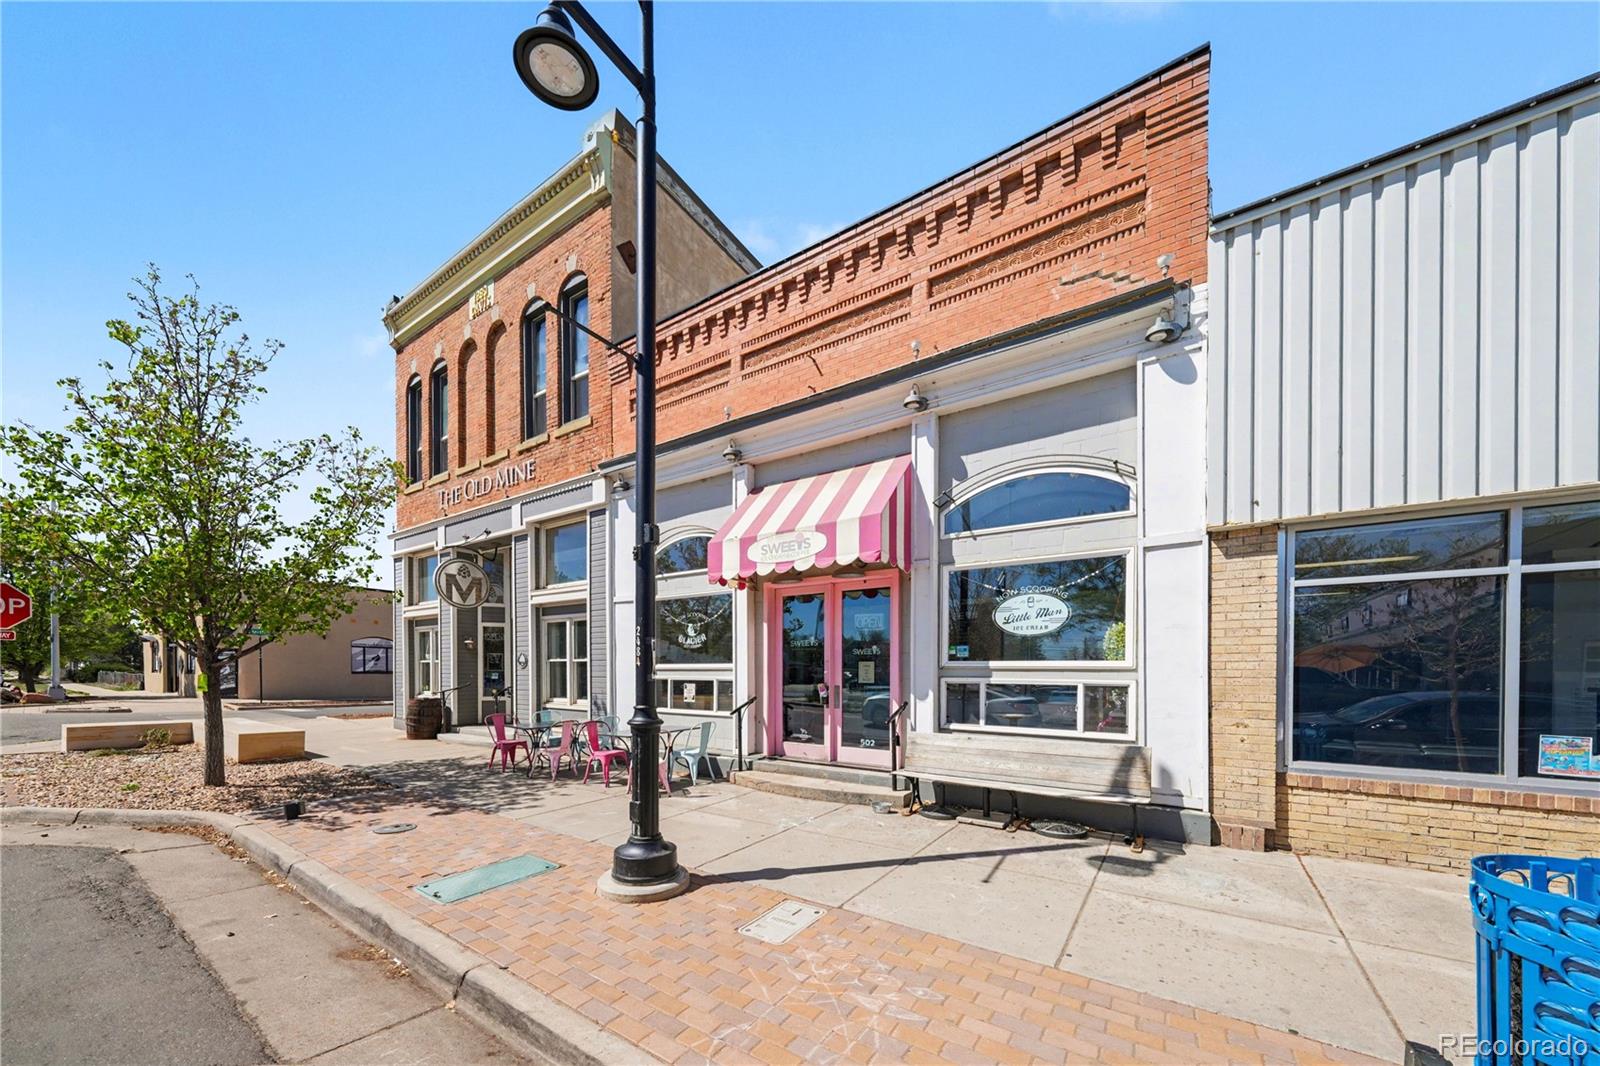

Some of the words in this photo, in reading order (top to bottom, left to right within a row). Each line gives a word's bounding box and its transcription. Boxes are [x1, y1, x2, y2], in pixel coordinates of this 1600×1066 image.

[438, 486, 462, 510] THE
[463, 476, 493, 500] OLD
[495, 459, 536, 490] MINE
[995, 588, 1018, 602] NOW
[1020, 585, 1069, 599] SCOOPING
[1002, 611, 1031, 625] Little
[1035, 607, 1062, 620] Man
[860, 738, 875, 747] 502
